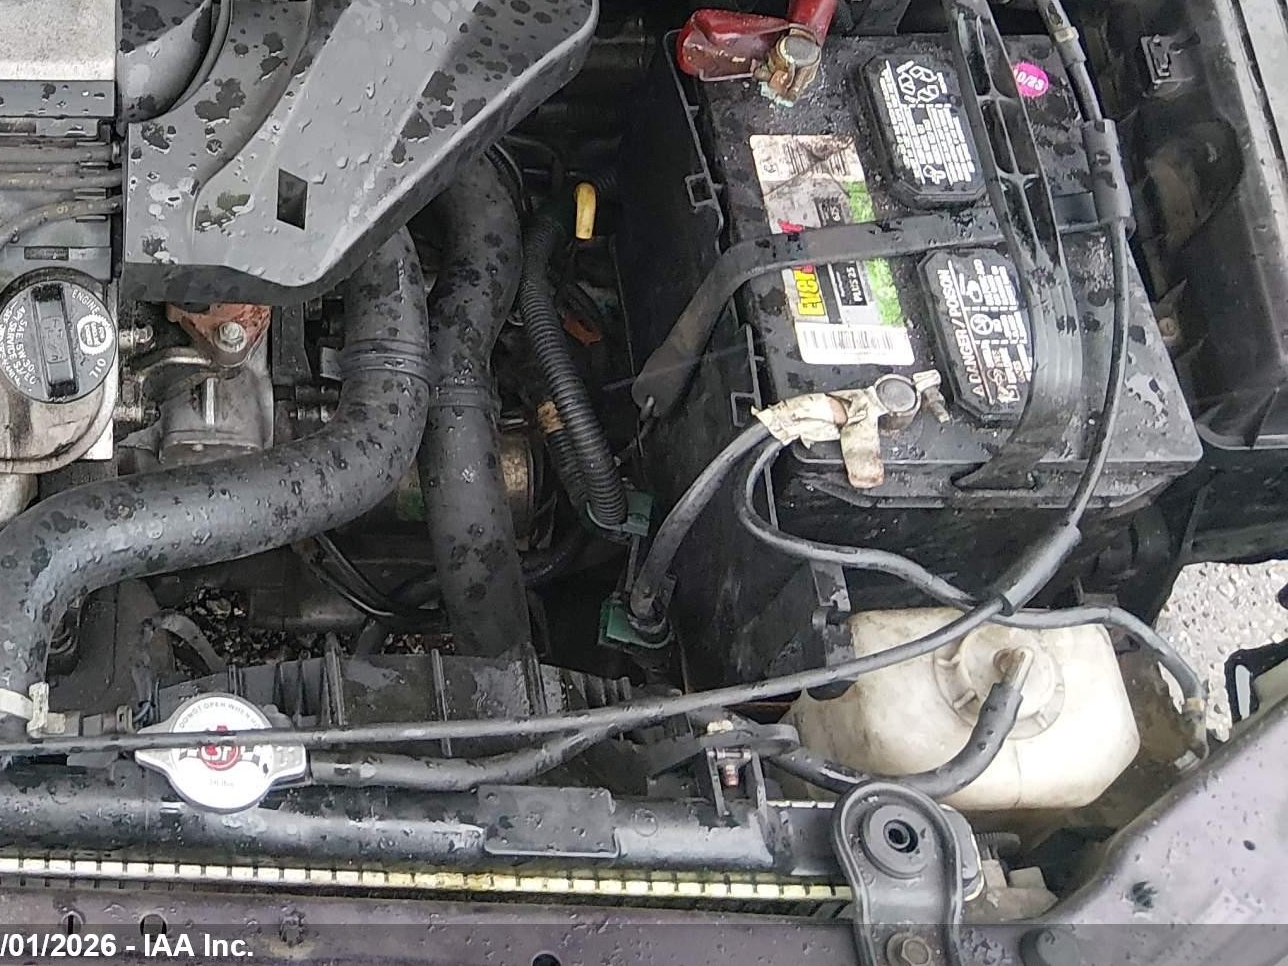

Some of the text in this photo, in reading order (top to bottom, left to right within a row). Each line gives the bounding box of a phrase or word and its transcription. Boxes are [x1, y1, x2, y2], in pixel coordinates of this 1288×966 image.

[937, 269, 962, 318] POISON
[6, 320, 18, 360] SERVICE
[15, 319, 36, 373] SAE 5W-30
[72, 289, 106, 379] ENGINE OIL
[955, 329, 982, 384] DANGER
[203, 701, 227, 710] OPEN
[228, 702, 251, 719] WHEN
